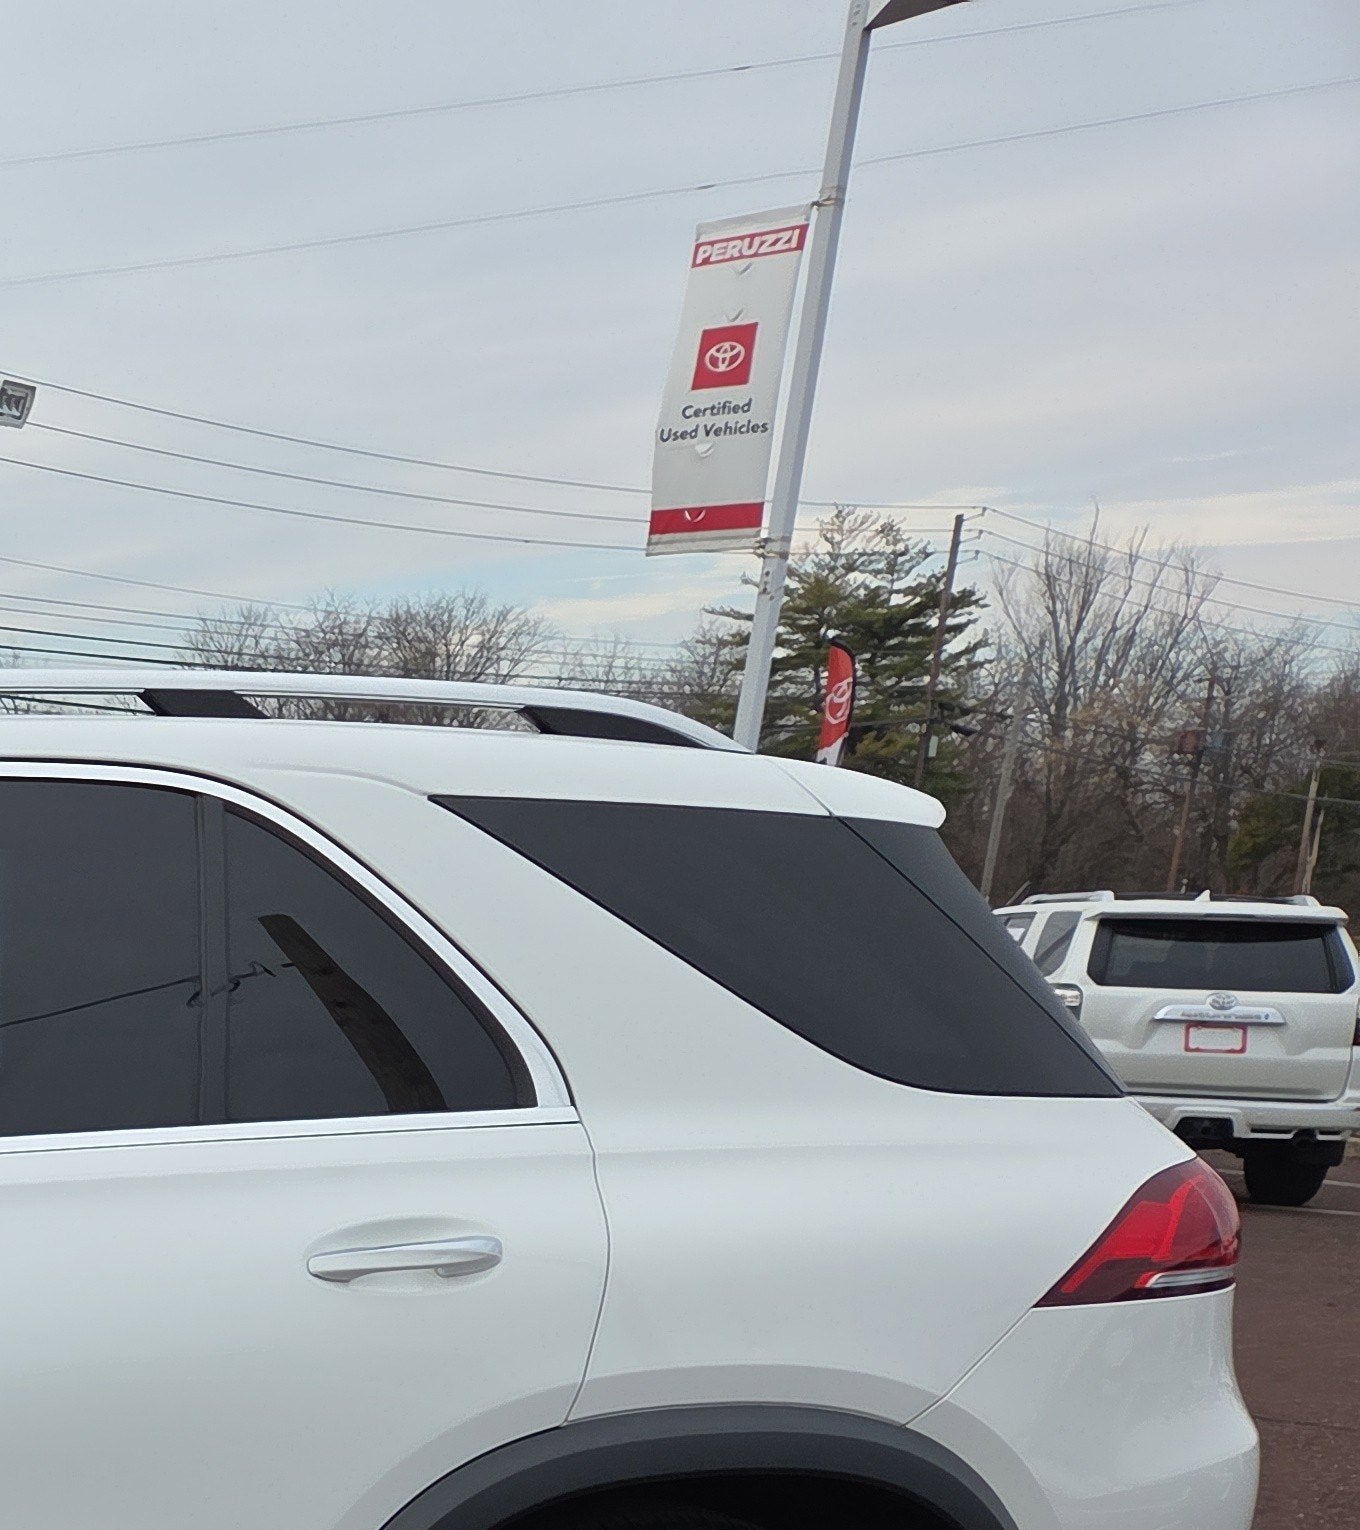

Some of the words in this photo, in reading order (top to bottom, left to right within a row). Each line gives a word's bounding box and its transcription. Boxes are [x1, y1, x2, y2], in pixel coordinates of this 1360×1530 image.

[695, 228, 800, 265] PERUZZI
[681, 398, 753, 419] Certified
[659, 424, 699, 443] Used
[703, 418, 770, 438] Vehicles
